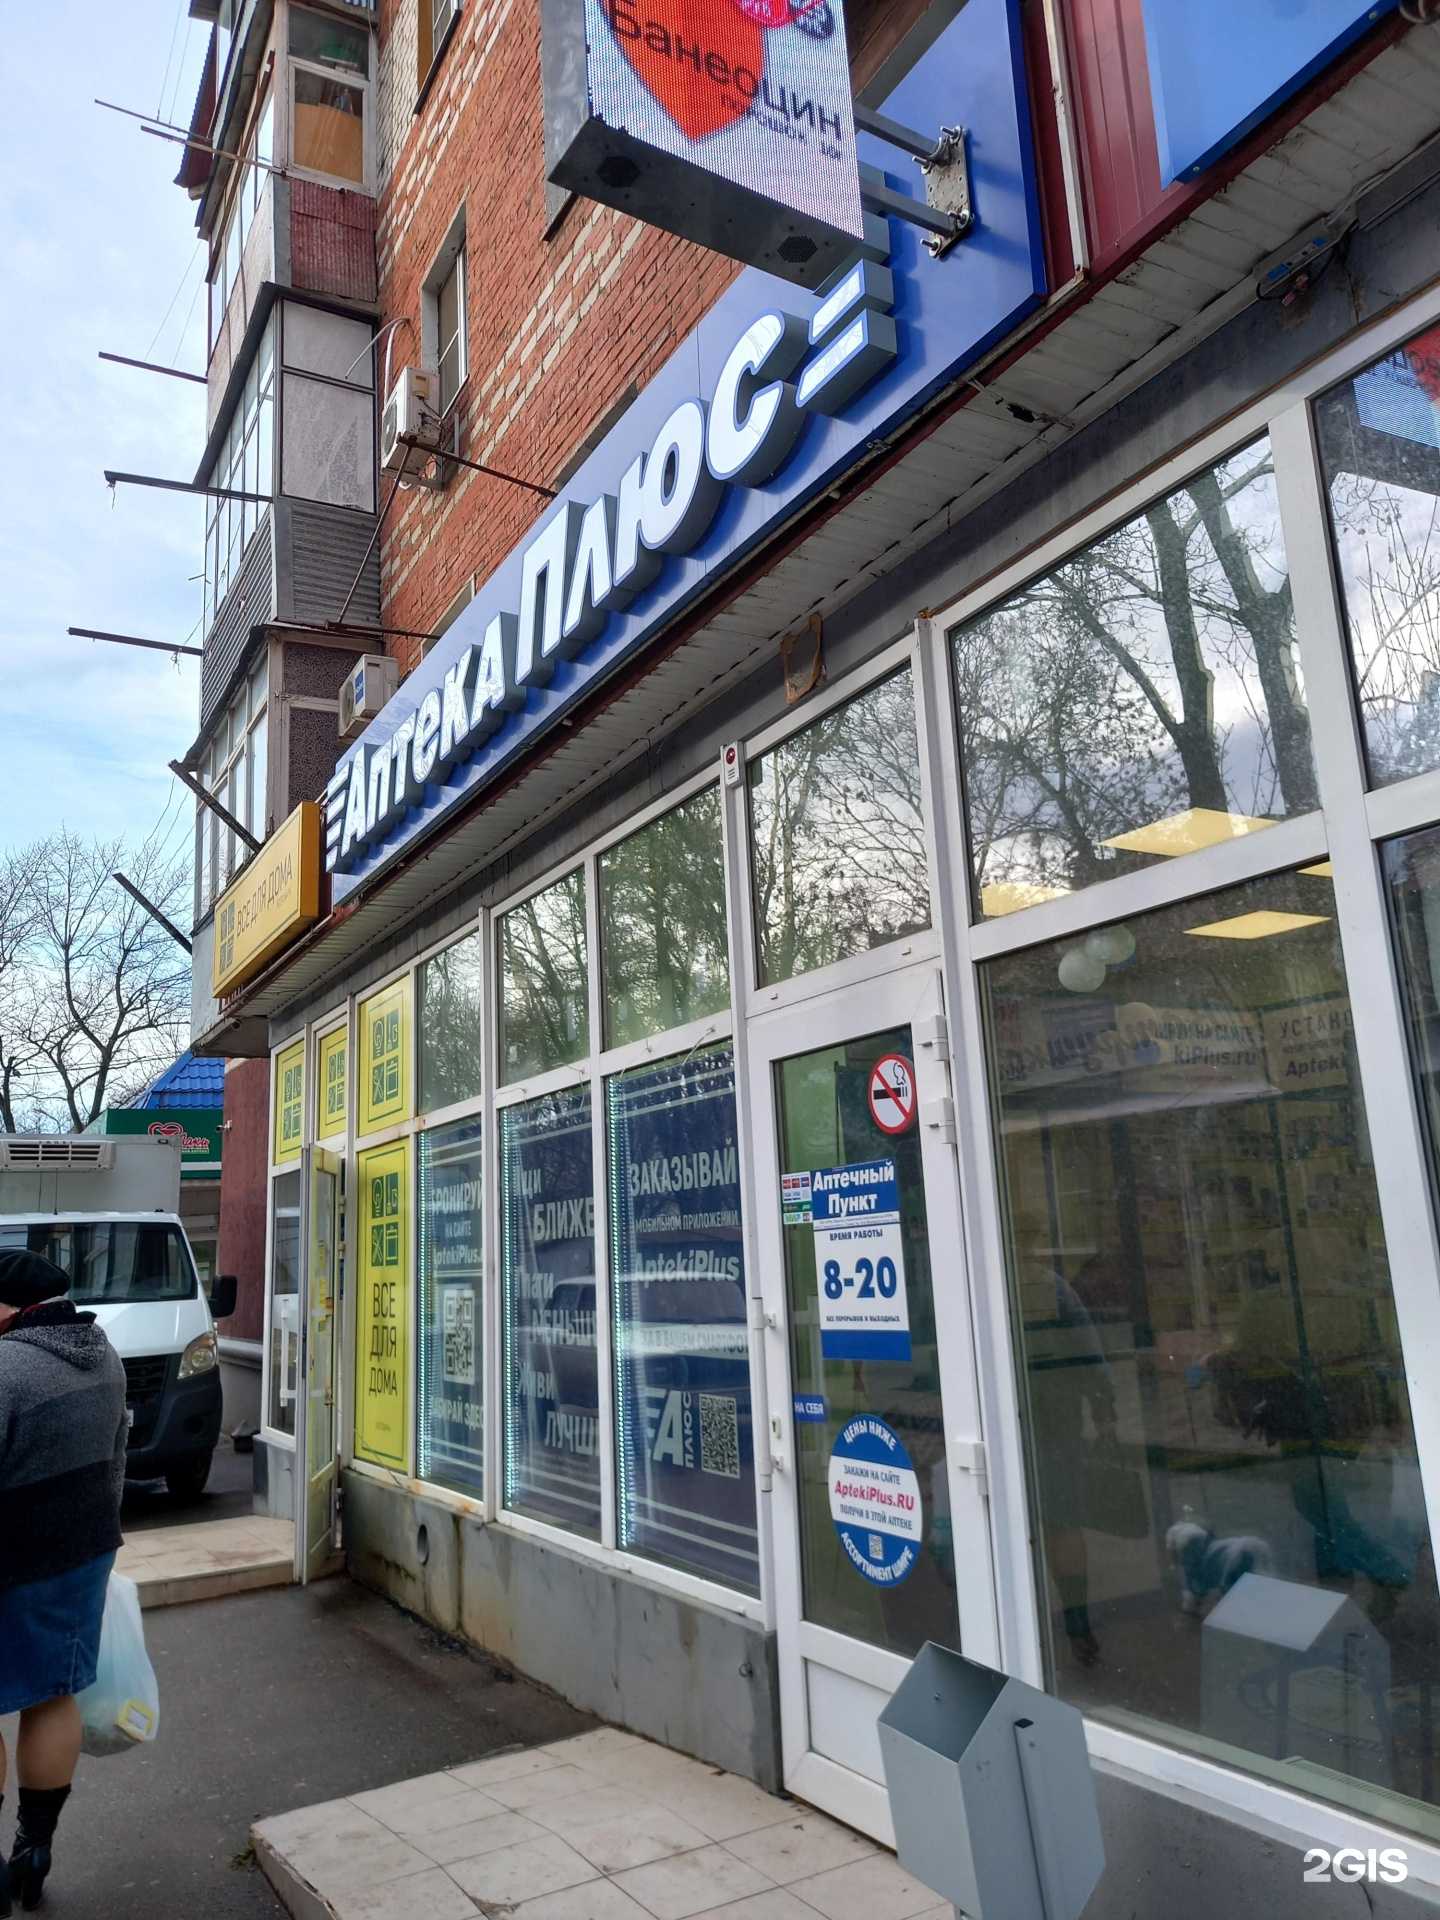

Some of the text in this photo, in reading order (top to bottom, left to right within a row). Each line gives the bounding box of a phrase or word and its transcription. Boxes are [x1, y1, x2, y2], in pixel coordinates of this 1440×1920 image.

[267, 851, 294, 910] ДОМА
[631, 1137, 737, 1197] ЗАКАЗЫВАЙ
[813, 1161, 895, 1192] Аптечный
[534, 1197, 594, 1241] БЛИЖЕ
[827, 1193, 878, 1218] Пункт
[829, 1228, 883, 1241] ВРЕМЯ РАБОТЫ
[634, 1250, 740, 1288] AptekiPlus
[824, 1256, 897, 1300] 8-20
[372, 1282, 396, 1319] ВСЕ
[370, 1326, 397, 1362] ДЛЯ
[368, 1367, 398, 1398] ДОМА
[843, 1420, 896, 1451] ЦЕНЫ НИЖЕ
[844, 1464, 870, 1477] ЗАКАЖИ
[880, 1470, 900, 1485] САЙТЕ
[834, 1480, 914, 1511] AptekiPlus.RU
[870, 1510, 888, 1523] ЭТОЙ
[888, 1515, 912, 1530] АПТЕКЕ
